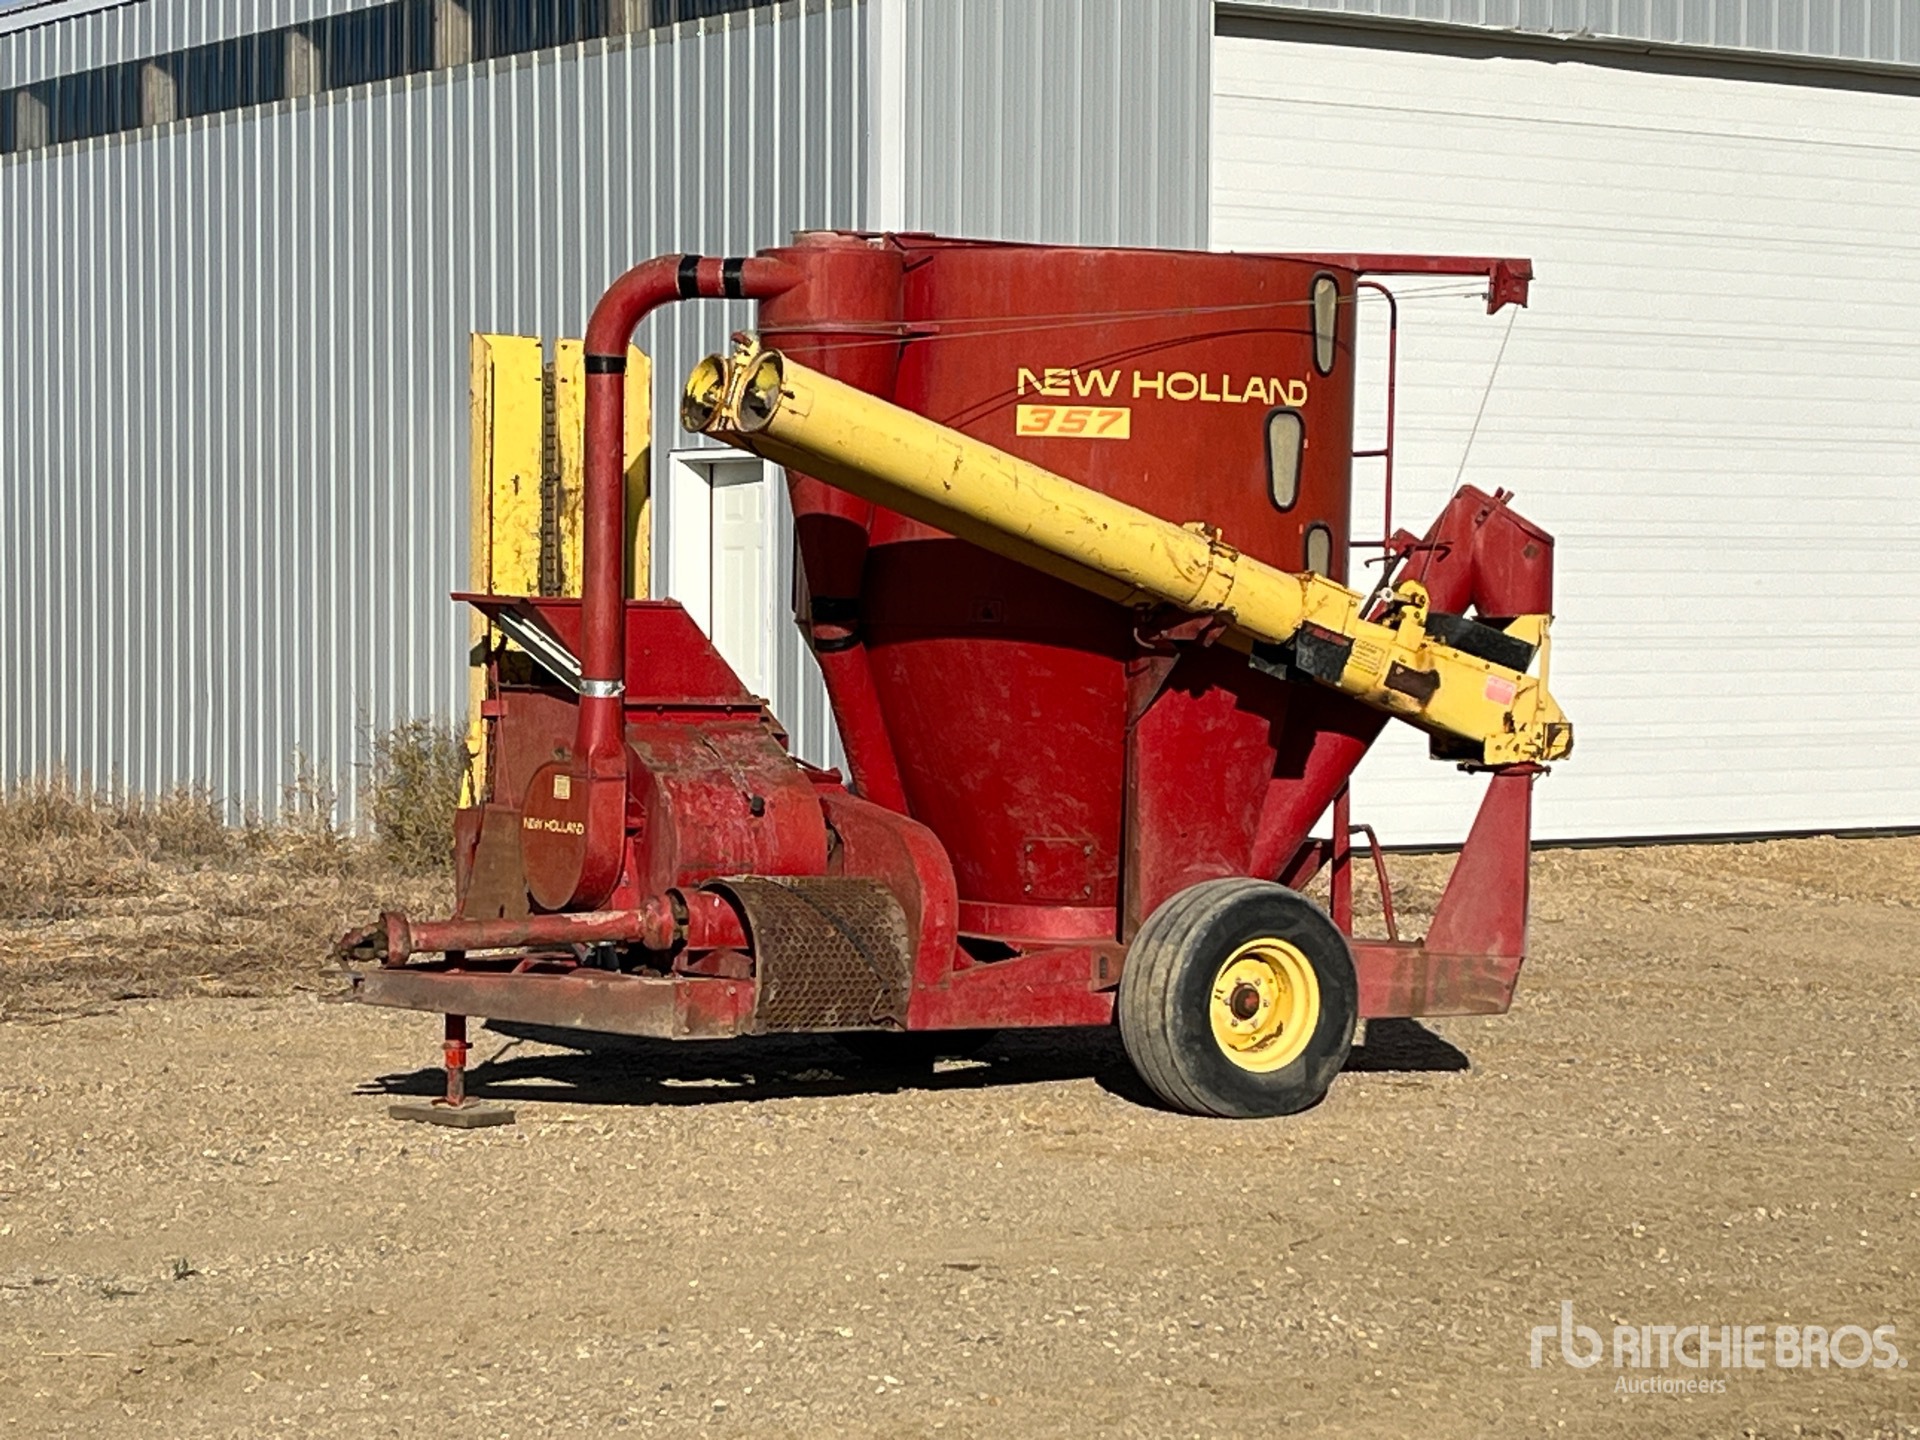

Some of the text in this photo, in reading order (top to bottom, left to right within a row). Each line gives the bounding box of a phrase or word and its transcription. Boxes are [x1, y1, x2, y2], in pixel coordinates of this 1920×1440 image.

[1017, 367, 1308, 407] NEW HOLLAND
[1021, 408, 1123, 434] 357
